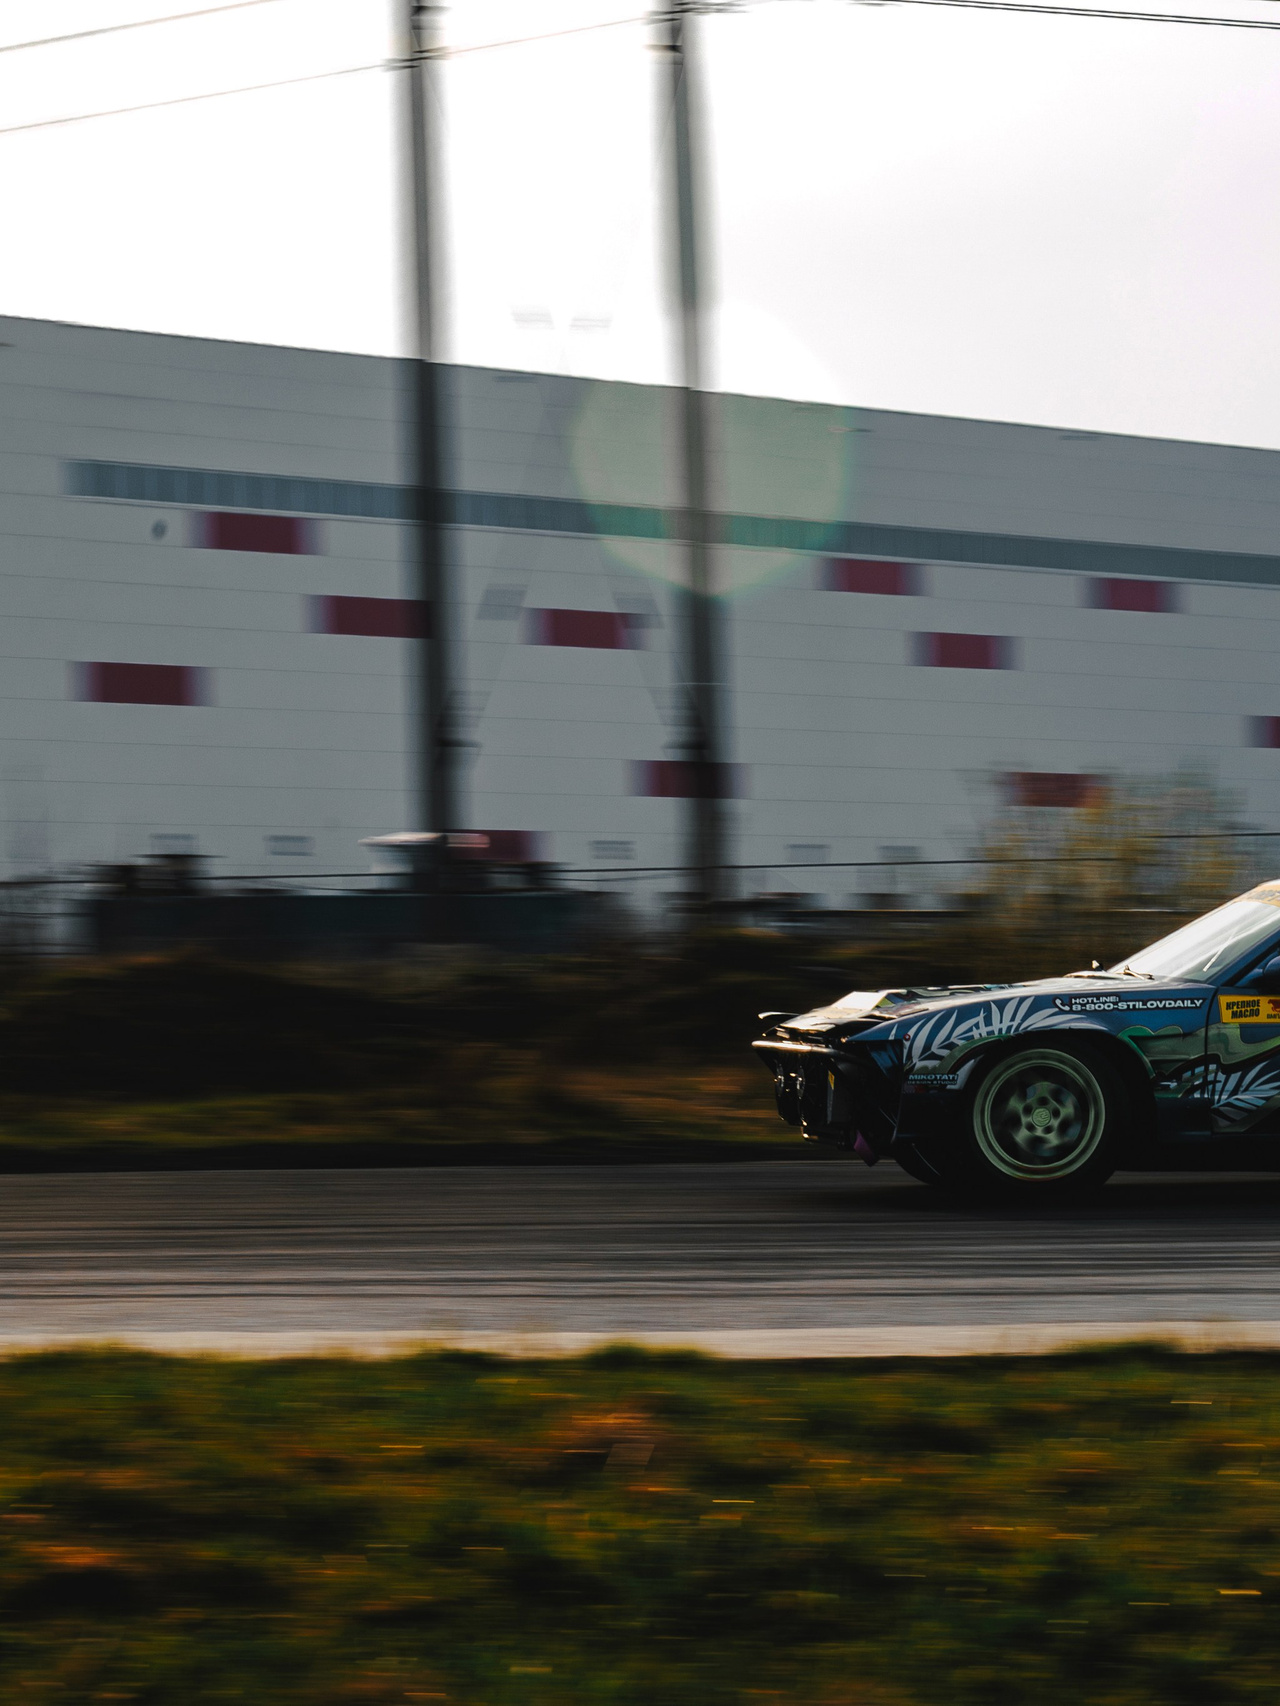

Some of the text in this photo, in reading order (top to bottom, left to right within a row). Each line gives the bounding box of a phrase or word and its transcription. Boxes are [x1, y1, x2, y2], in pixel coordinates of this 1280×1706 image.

[1071, 996, 1119, 1004] HOTLINE:
[1072, 999, 1203, 1011] 8-800-STILOVDAILY
[1226, 999, 1261, 1010] КРЕПКОЕ
[1231, 1008, 1260, 1019] МАСЛО
